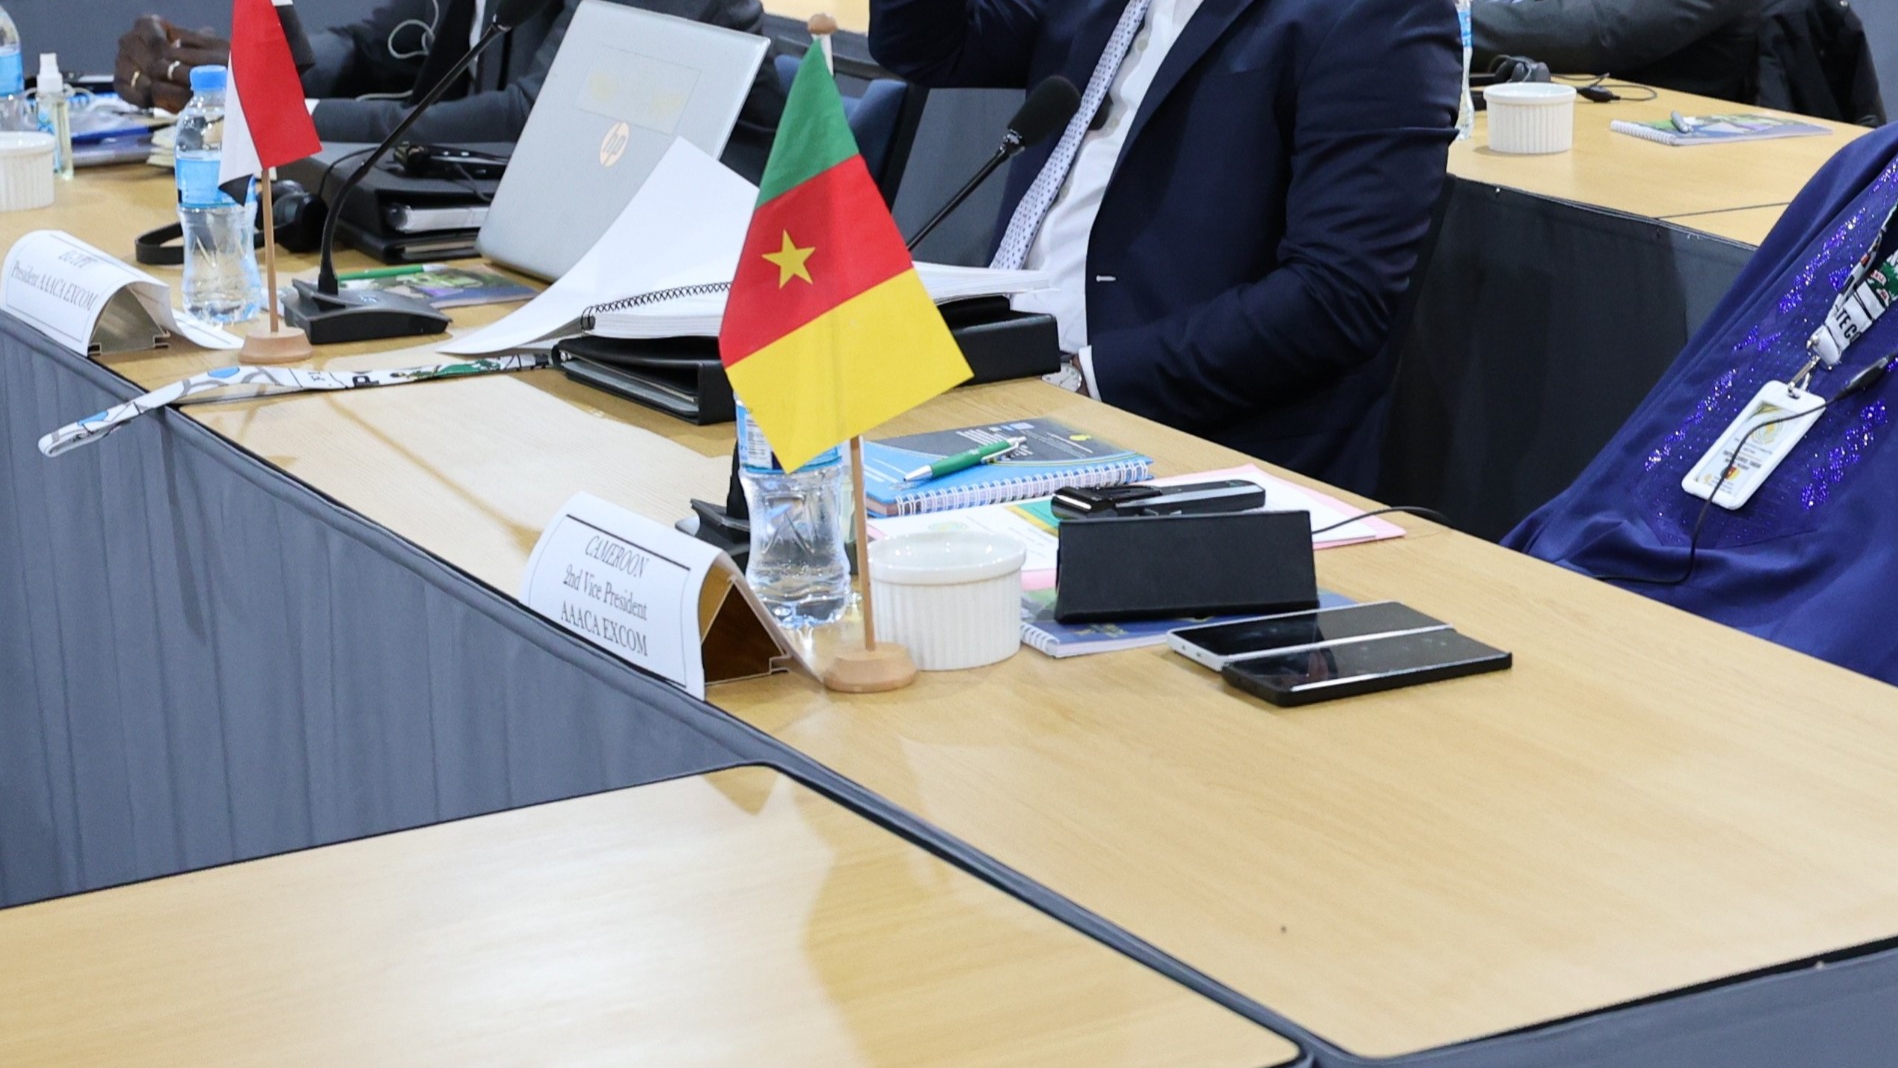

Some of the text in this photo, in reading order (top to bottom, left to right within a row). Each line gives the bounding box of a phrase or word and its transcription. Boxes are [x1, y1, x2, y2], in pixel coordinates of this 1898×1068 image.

[585, 535, 649, 578] CAMEROON
[563, 564, 648, 621] 2nd Vice President
[561, 600, 648, 657] AAACA EXCOM
